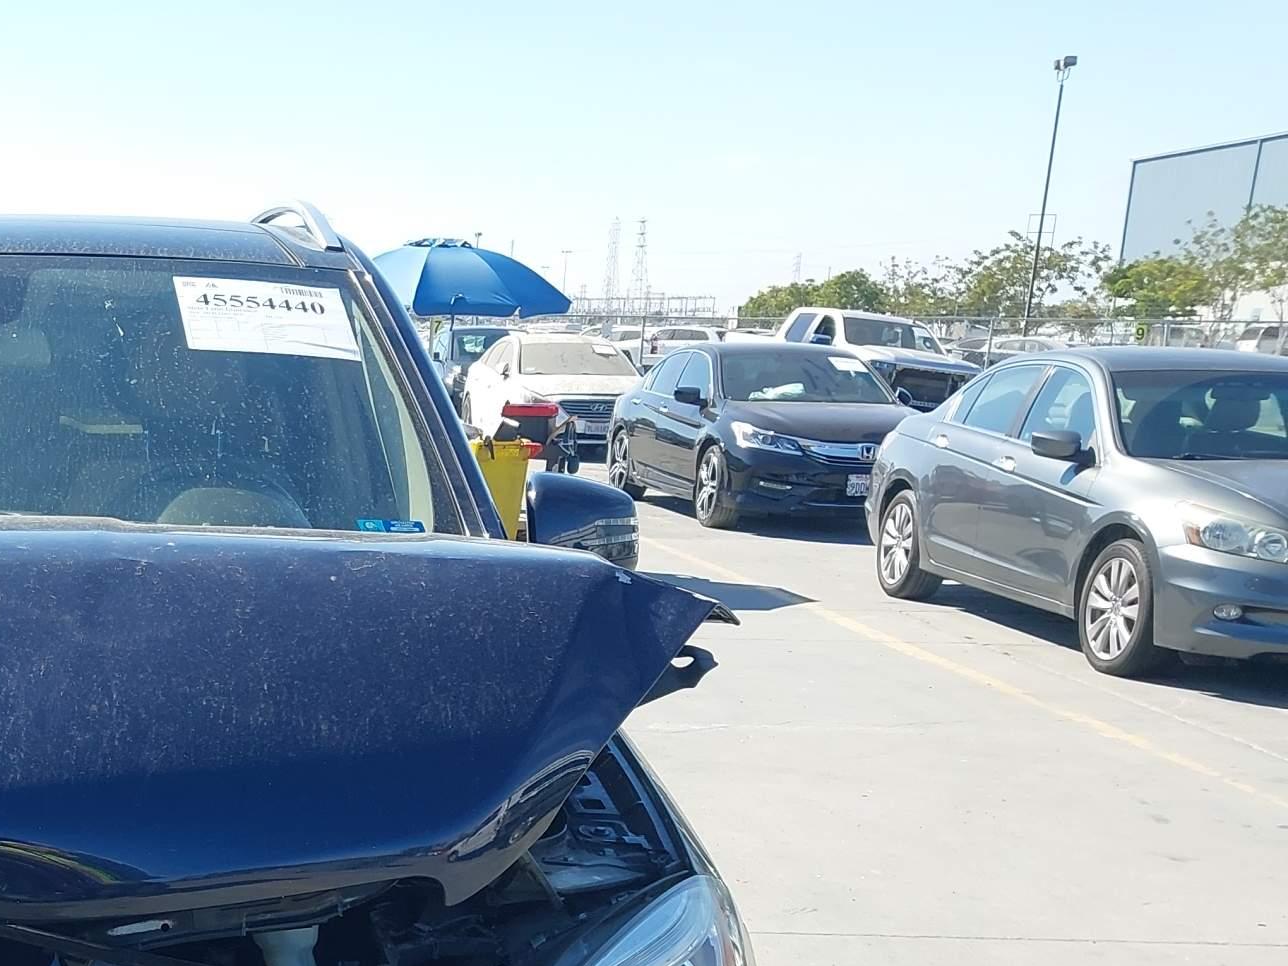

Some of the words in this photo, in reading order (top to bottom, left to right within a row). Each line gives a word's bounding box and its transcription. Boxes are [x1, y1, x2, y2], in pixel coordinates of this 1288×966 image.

[195, 292, 326, 316] 45554440
[434, 320, 442, 334] 7
[1136, 327, 1145, 341] 9
